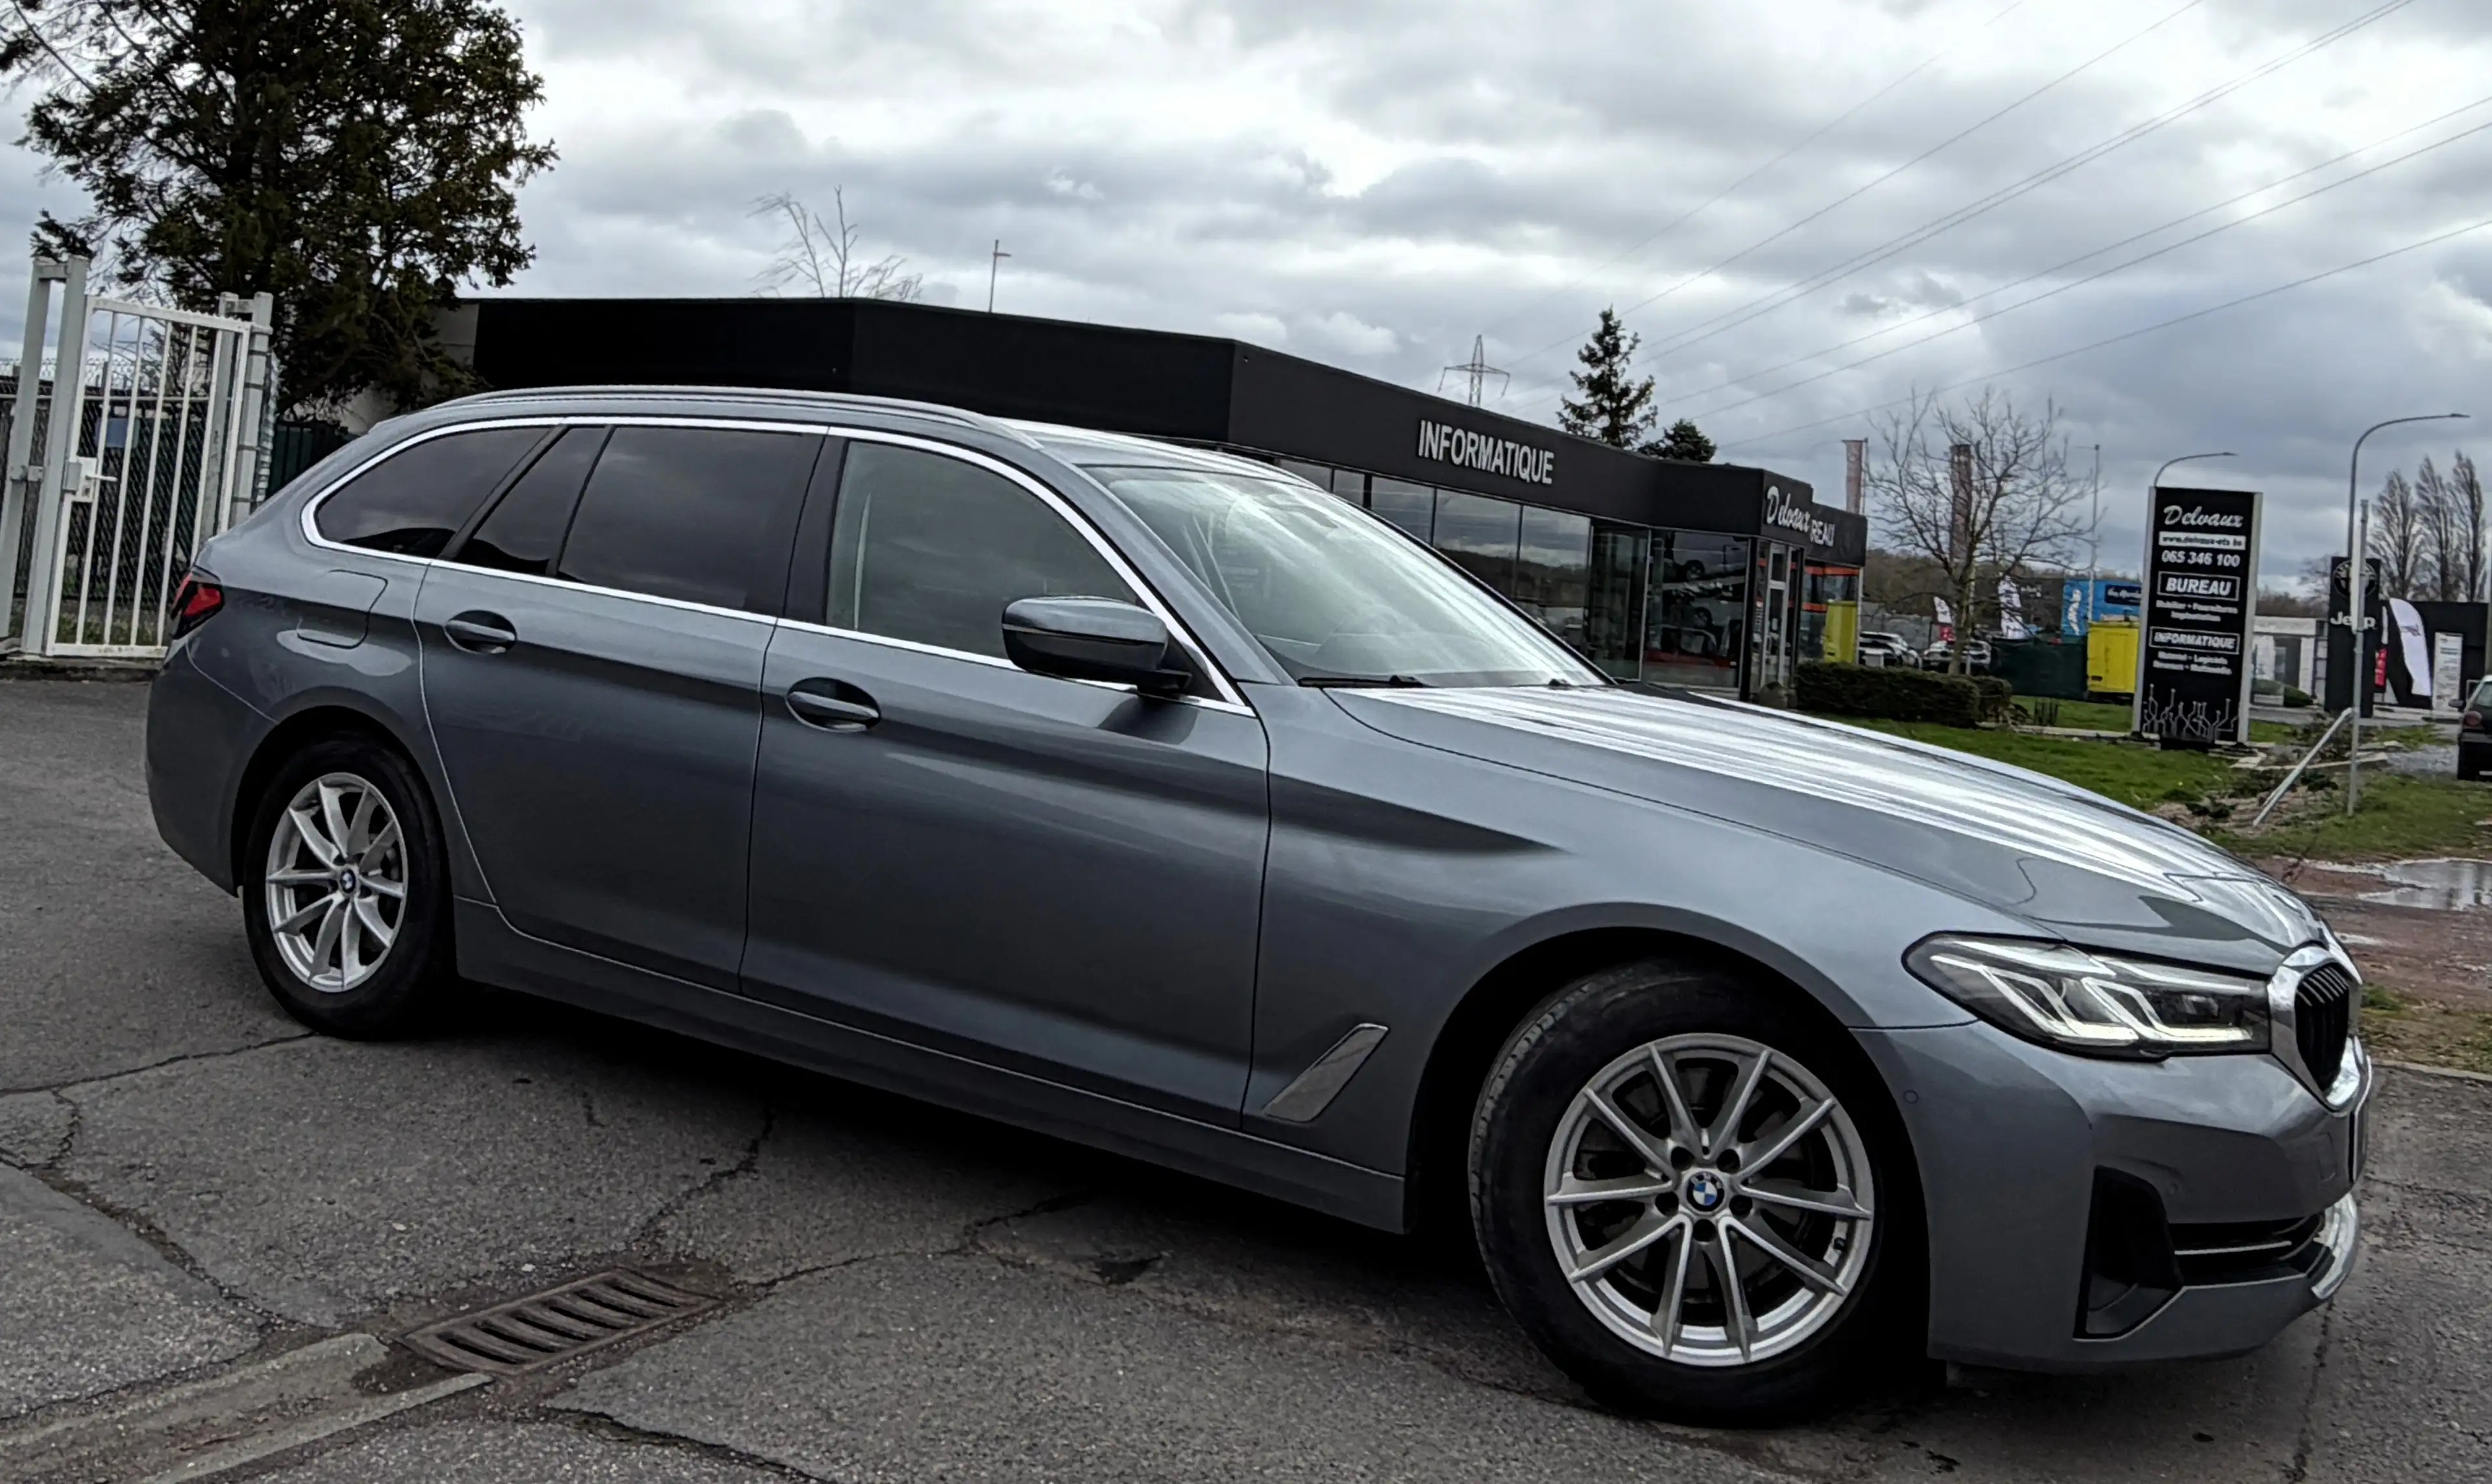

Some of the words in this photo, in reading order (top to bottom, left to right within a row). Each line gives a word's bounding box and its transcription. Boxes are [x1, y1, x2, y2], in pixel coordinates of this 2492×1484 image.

[1418, 419, 1556, 485] INFORMATIQUE
[2163, 504, 2244, 528] Delvaux
[1809, 518, 1835, 547] REAU
[2161, 550, 2186, 563] 065
[2187, 551, 2214, 565] 346
[2216, 553, 2241, 568] 100
[2166, 577, 2232, 596] BUREAU
[2329, 611, 2376, 630] Jep
[2154, 631, 2236, 650] INFORMATIQUE
